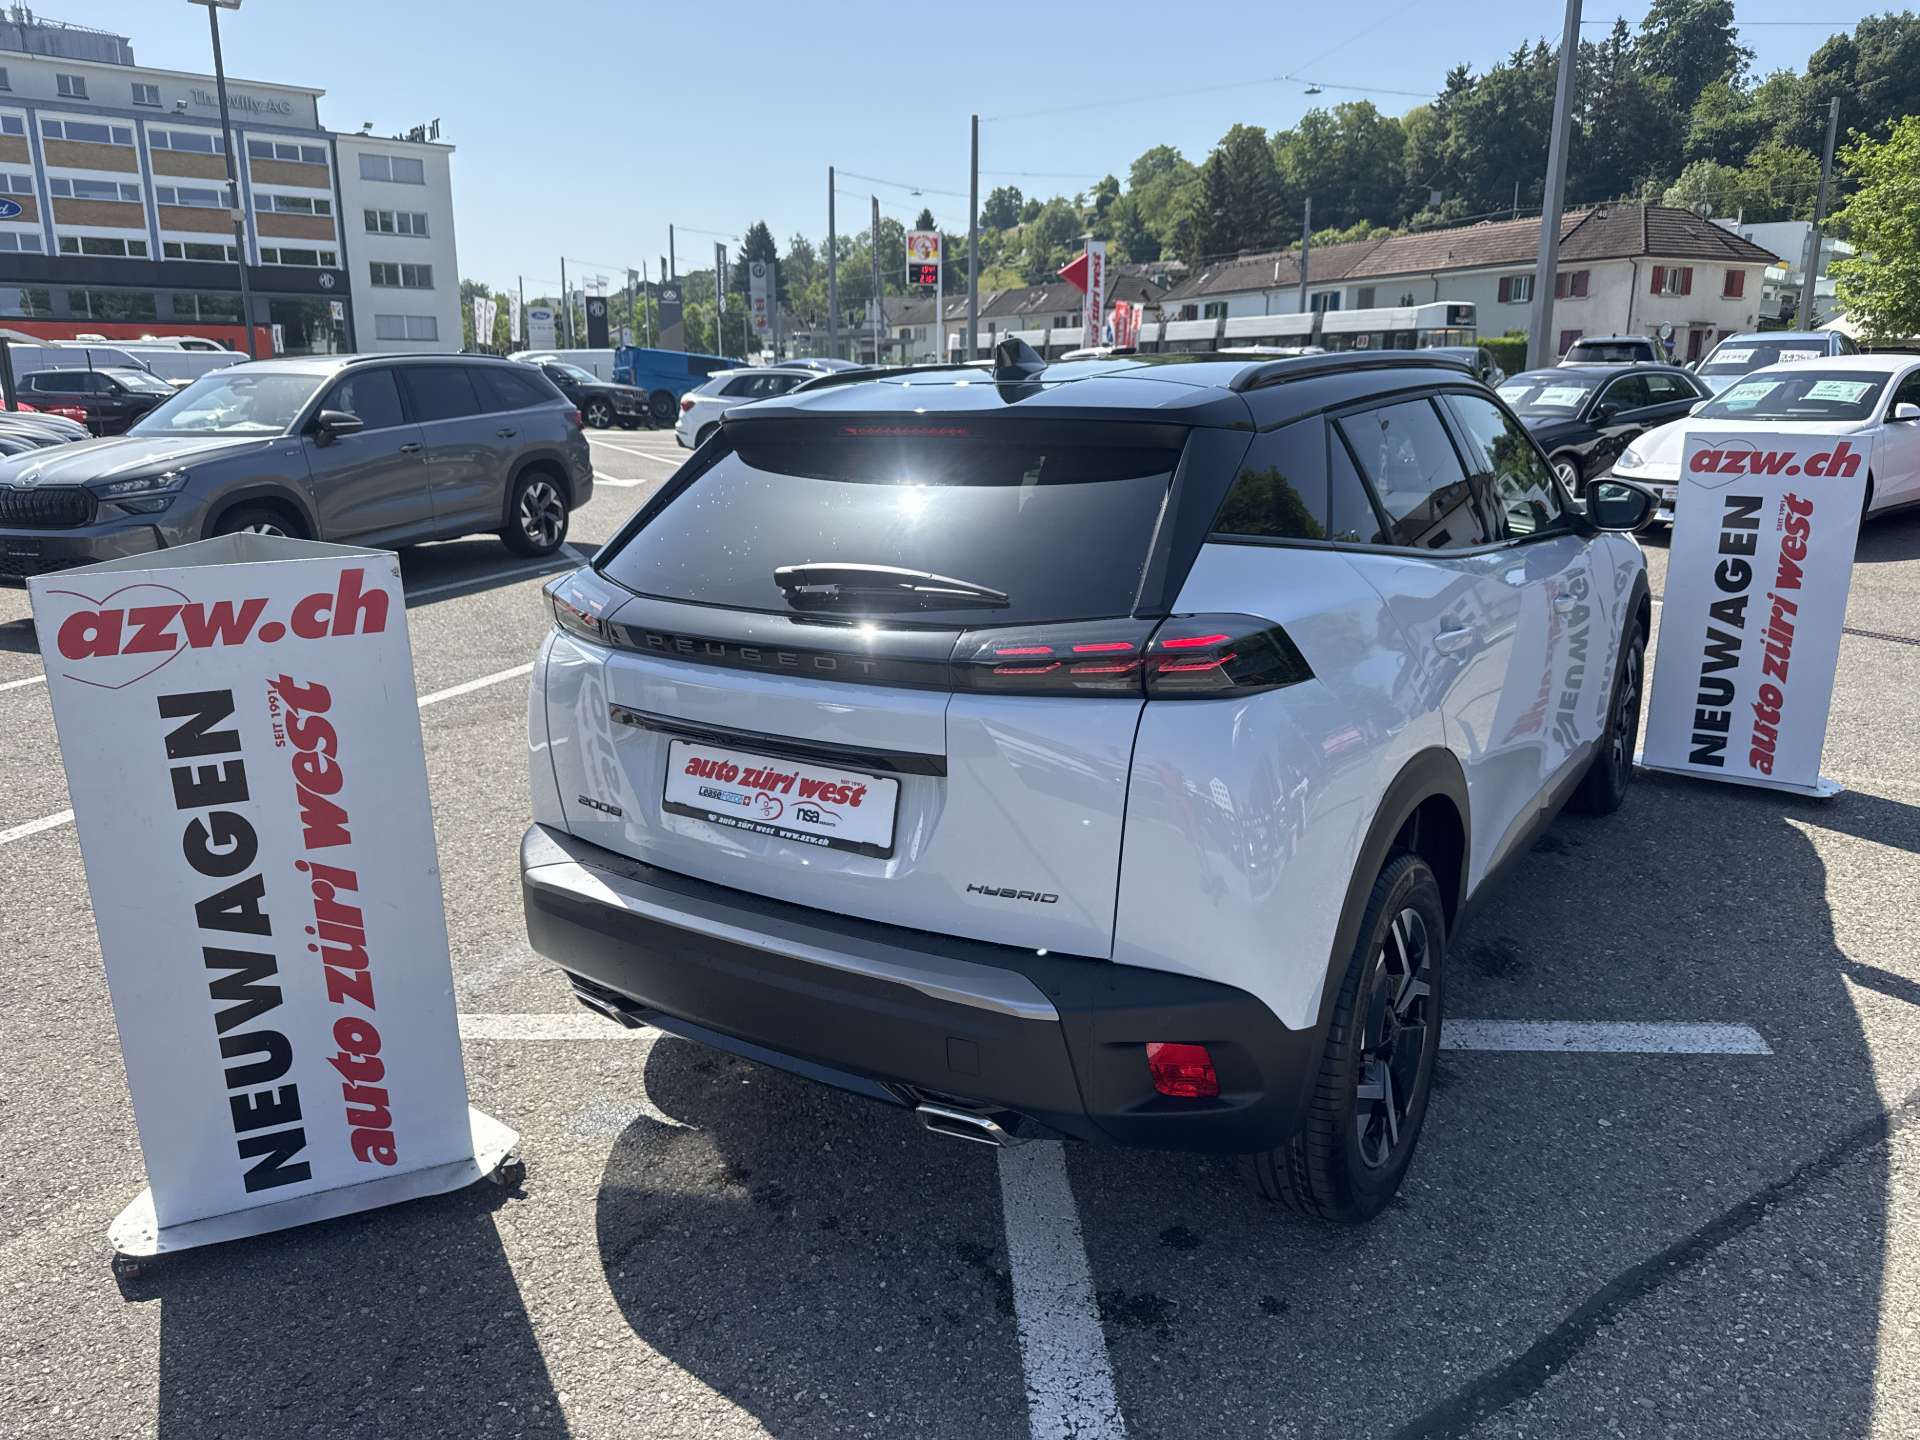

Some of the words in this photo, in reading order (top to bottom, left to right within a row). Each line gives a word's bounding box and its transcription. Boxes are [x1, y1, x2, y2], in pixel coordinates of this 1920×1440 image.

[1689, 441, 1862, 478] azw.ch
[1775, 492, 1814, 590] west
[1776, 516, 1784, 531] SEIT
[57, 568, 389, 660] azw.ch
[1688, 495, 1764, 767] NEUWAGEN
[1759, 591, 1798, 685] züri
[646, 634, 876, 674] PEUGEOT
[267, 690, 281, 718] 1991
[272, 723, 286, 747] SEIT
[1749, 683, 1784, 775] auto
[266, 674, 353, 850] west
[685, 757, 739, 783] auto
[737, 766, 799, 794] züri
[798, 777, 868, 808] west
[718, 816, 736, 827] auto
[779, 830, 830, 847] www.azw.ch
[796, 807, 820, 825] nsa
[966, 883, 1059, 904] HYBRID
[157, 689, 312, 1193] NEUWAGEN
[295, 859, 376, 1011] züri
[326, 1016, 398, 1166] auto
